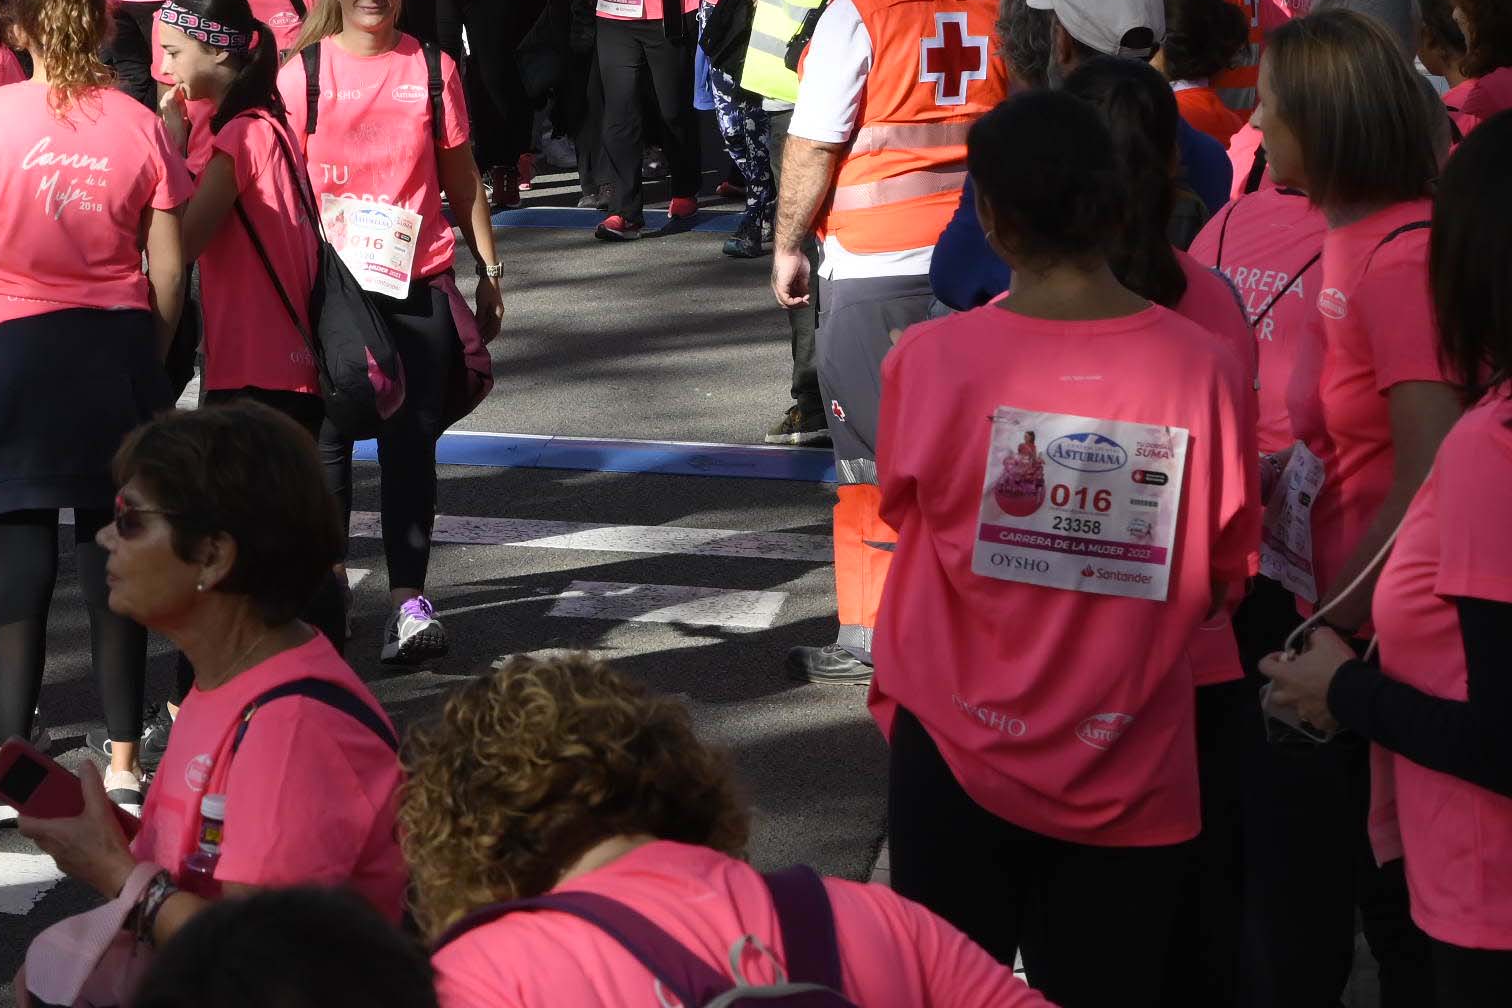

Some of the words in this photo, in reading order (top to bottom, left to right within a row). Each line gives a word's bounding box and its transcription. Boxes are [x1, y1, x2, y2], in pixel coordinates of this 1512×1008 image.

[320, 163, 351, 185] TU
[1052, 443, 1121, 467] ASTURIANA
[1135, 448, 1170, 460] SUMA
[1050, 483, 1113, 513] 016
[1052, 515, 1102, 535] 23358
[999, 530, 1052, 547] CARRERA
[1053, 538, 1071, 550] DE
[1071, 541, 1086, 551] LA
[1087, 543, 1124, 555] MUJER
[990, 552, 1050, 574] OYSHO
[1095, 567, 1153, 585] Santander
